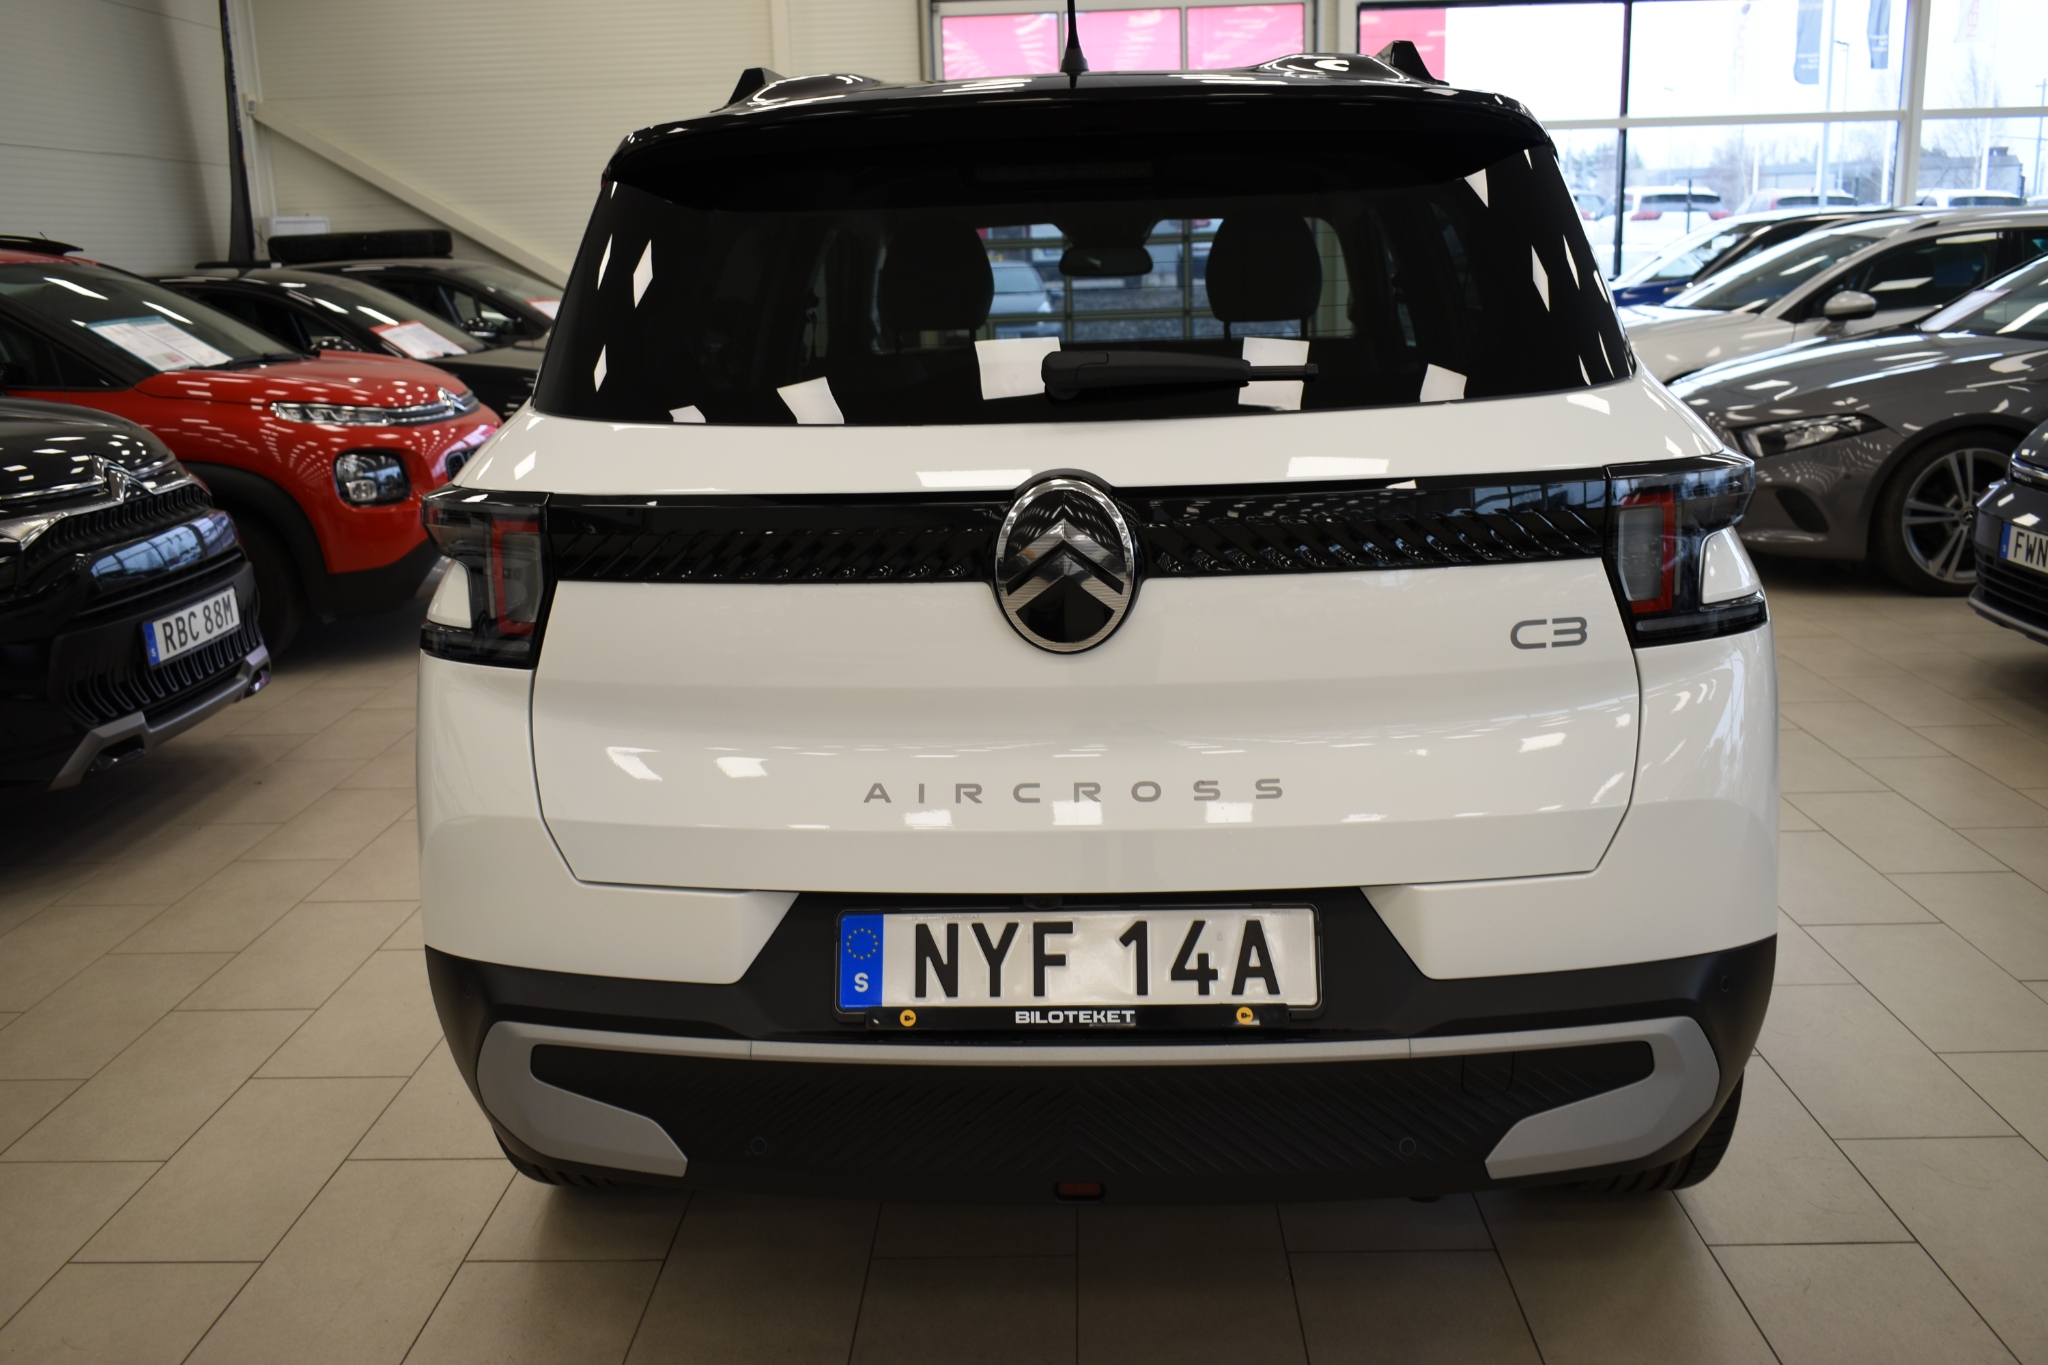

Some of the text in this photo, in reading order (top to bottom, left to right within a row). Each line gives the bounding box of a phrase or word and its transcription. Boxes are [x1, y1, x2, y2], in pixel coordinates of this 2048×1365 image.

[2013, 531, 2048, 568] FWN
[162, 594, 234, 654] RBC 88M
[1510, 616, 1588, 651] C3
[151, 648, 156, 657] S
[863, 778, 1284, 804] AIRCROSS
[914, 919, 1281, 998] NYF 14A
[853, 972, 869, 993] S
[1014, 1009, 1136, 1025] BILOTEKET
